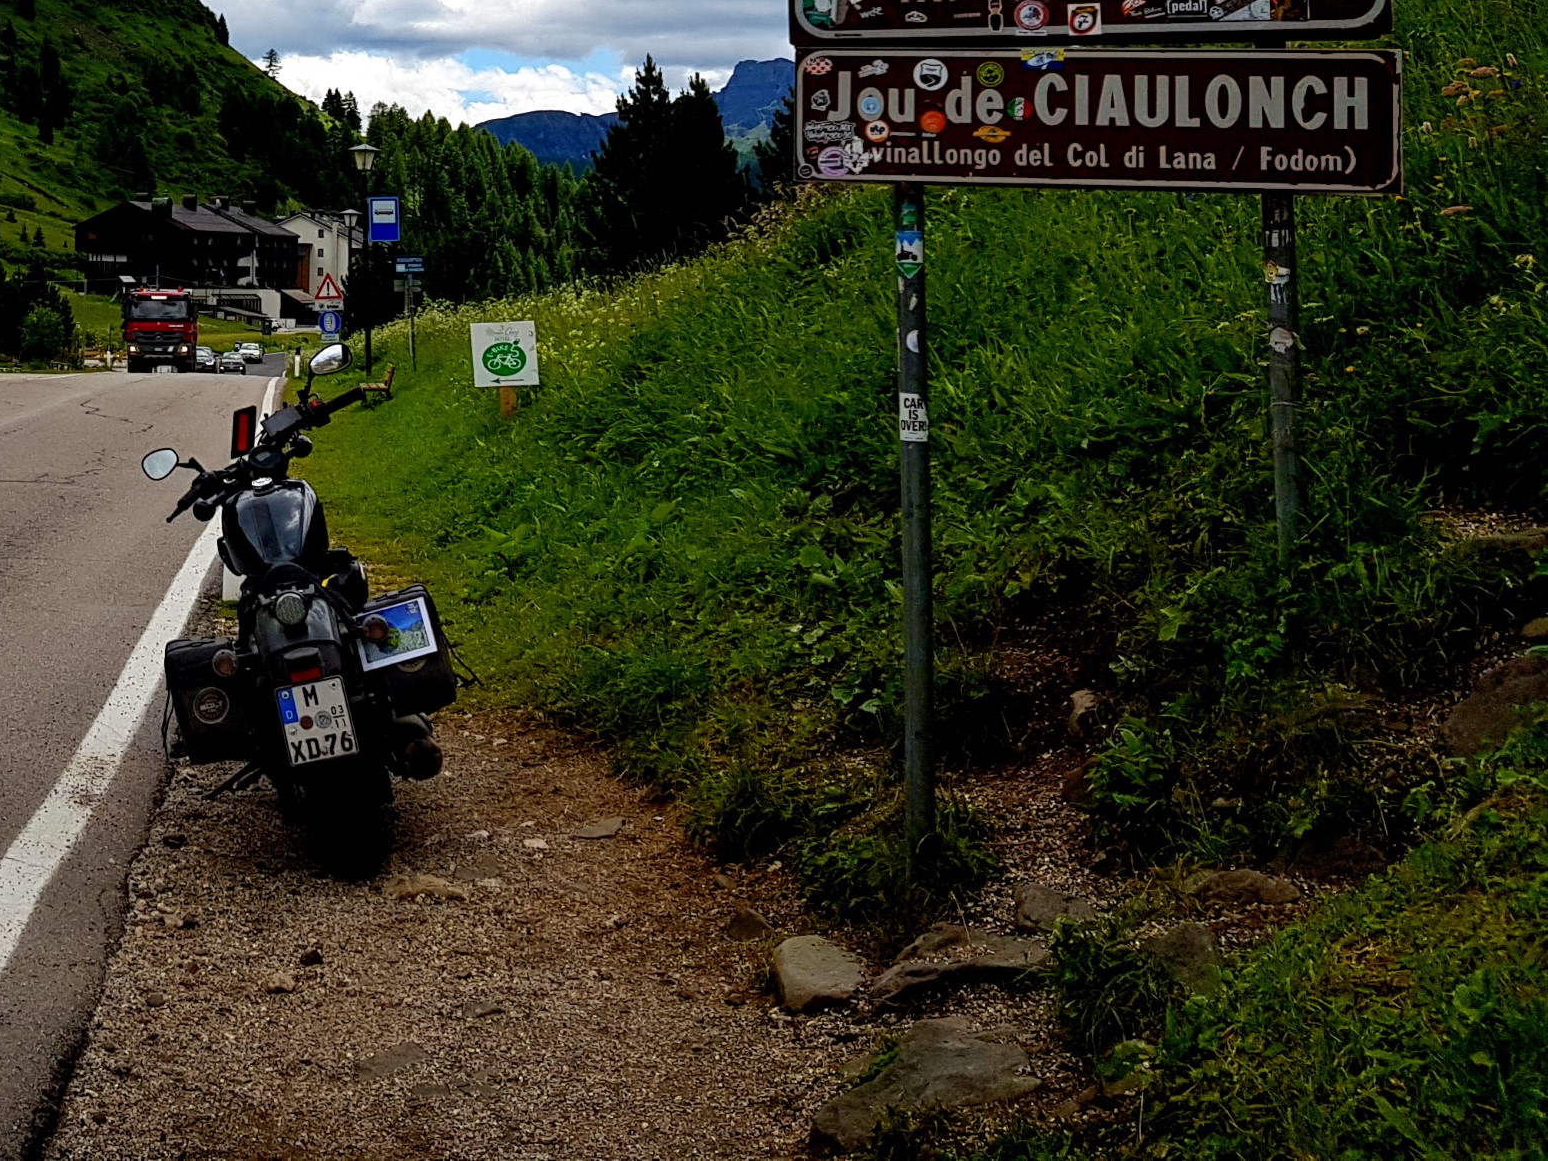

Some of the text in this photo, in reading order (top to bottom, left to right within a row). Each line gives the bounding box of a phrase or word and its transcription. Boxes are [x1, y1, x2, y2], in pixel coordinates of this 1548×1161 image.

[827, 70, 1370, 130] Jou de CIAULONCH
[870, 139, 1002, 173] vinallongo
[1014, 142, 1054, 167] del
[1067, 142, 1110, 168] Col
[1123, 143, 1146, 169] di
[1159, 143, 1217, 171] Lana
[1259, 145, 1357, 174] Fodom)
[486, 345, 509, 358] E-BIKE
[904, 398, 923, 409] CAR
[908, 409, 919, 421] IS
[302, 685, 319, 707] M
[285, 710, 294, 720] D
[330, 704, 344, 715] 03
[291, 730, 354, 763] XD 76
